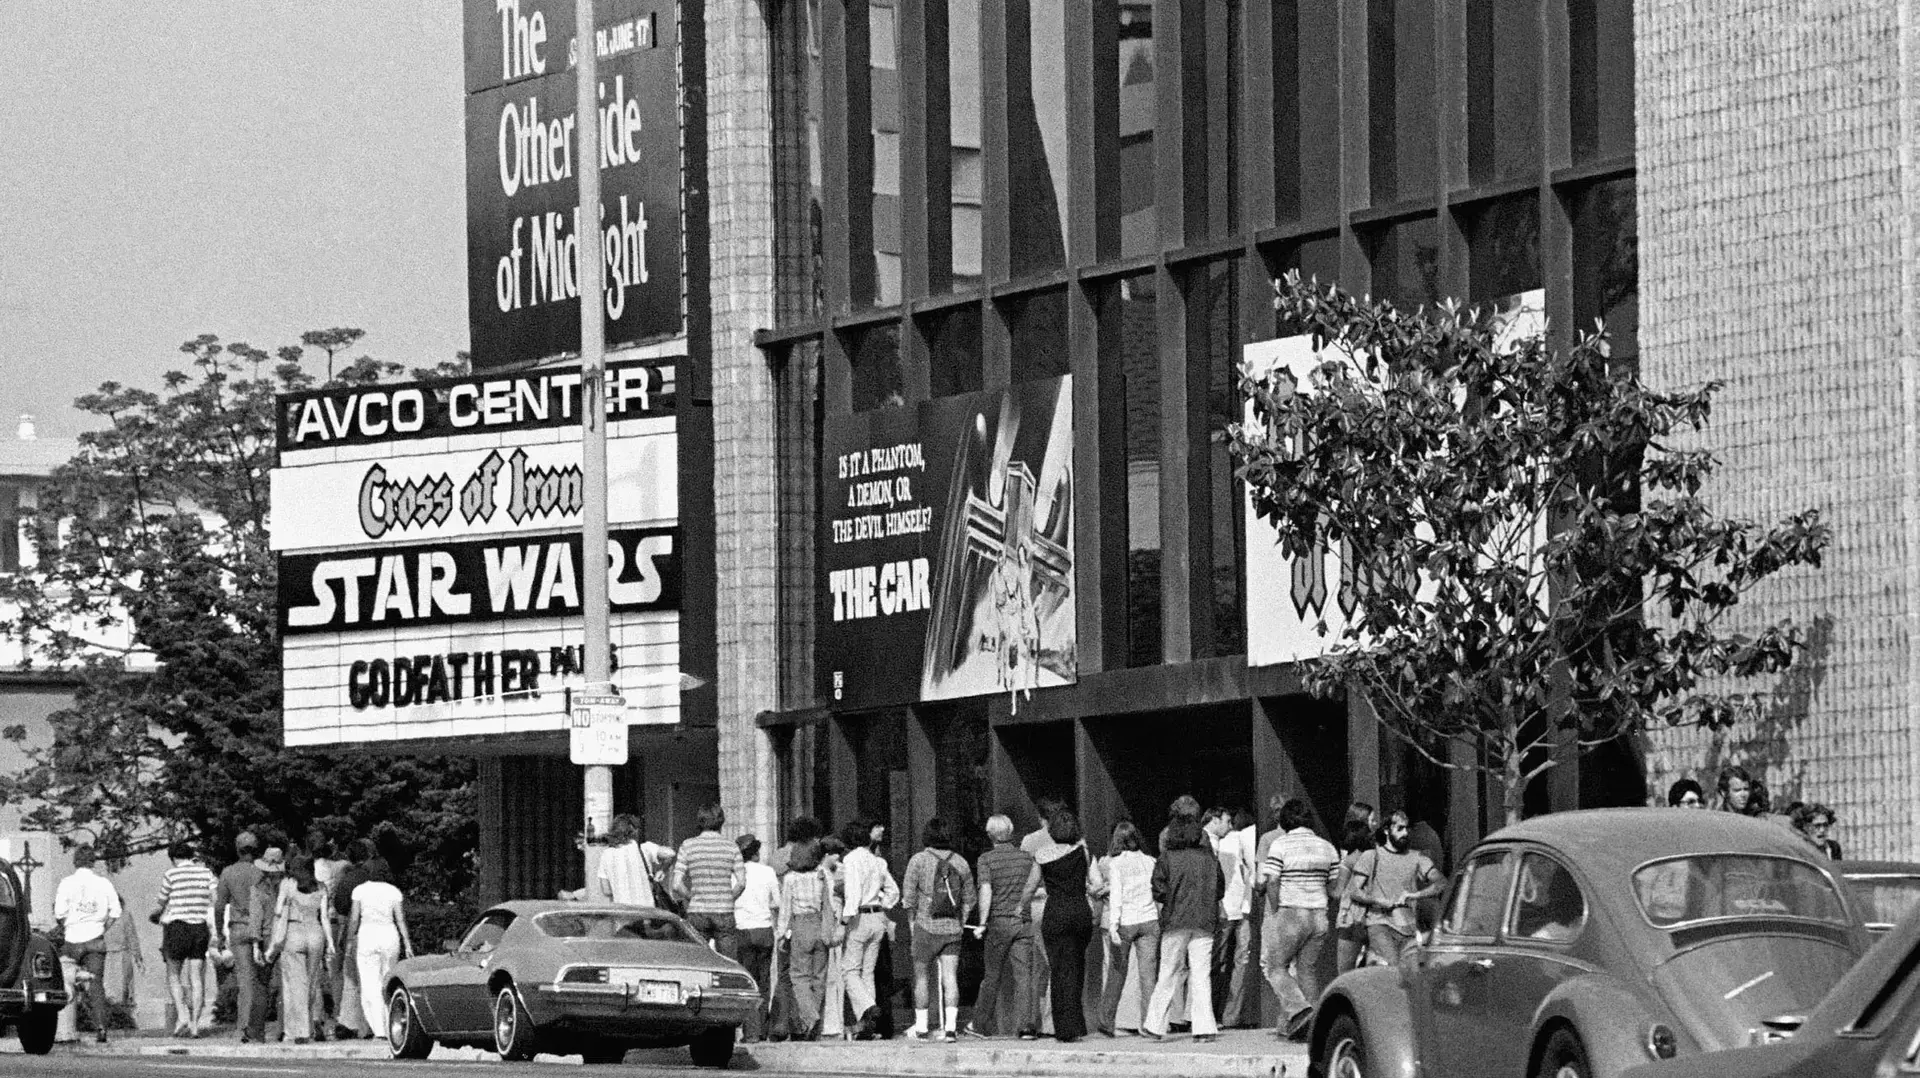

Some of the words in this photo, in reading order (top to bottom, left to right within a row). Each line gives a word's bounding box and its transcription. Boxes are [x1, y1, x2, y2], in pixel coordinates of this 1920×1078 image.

[497, 0, 547, 79] The
[609, 22, 634, 54] JUNE
[636, 18, 649, 47] 17
[499, 97, 574, 197] Other
[599, 75, 642, 169] ide
[497, 217, 523, 312] of
[530, 195, 648, 320] Midight
[296, 388, 424, 443] AVCO
[358, 462, 454, 539] Cross
[459, 449, 505, 526] of
[507, 447, 584, 526] Iron
[838, 455, 848, 479] IS
[850, 452, 861, 477] IT
[862, 450, 870, 474] A
[871, 443, 925, 472] PHANTOM,
[848, 484, 855, 507] A
[856, 479, 894, 509] DEMON,
[896, 476, 912, 502] OR
[832, 520, 853, 543] THE
[854, 515, 884, 540] DEVIL
[885, 506, 932, 536] HIMSELF?
[288, 551, 472, 627] STAR
[829, 566, 877, 622] THE
[879, 558, 931, 616] CAR
[349, 649, 541, 709] GODFATHER
